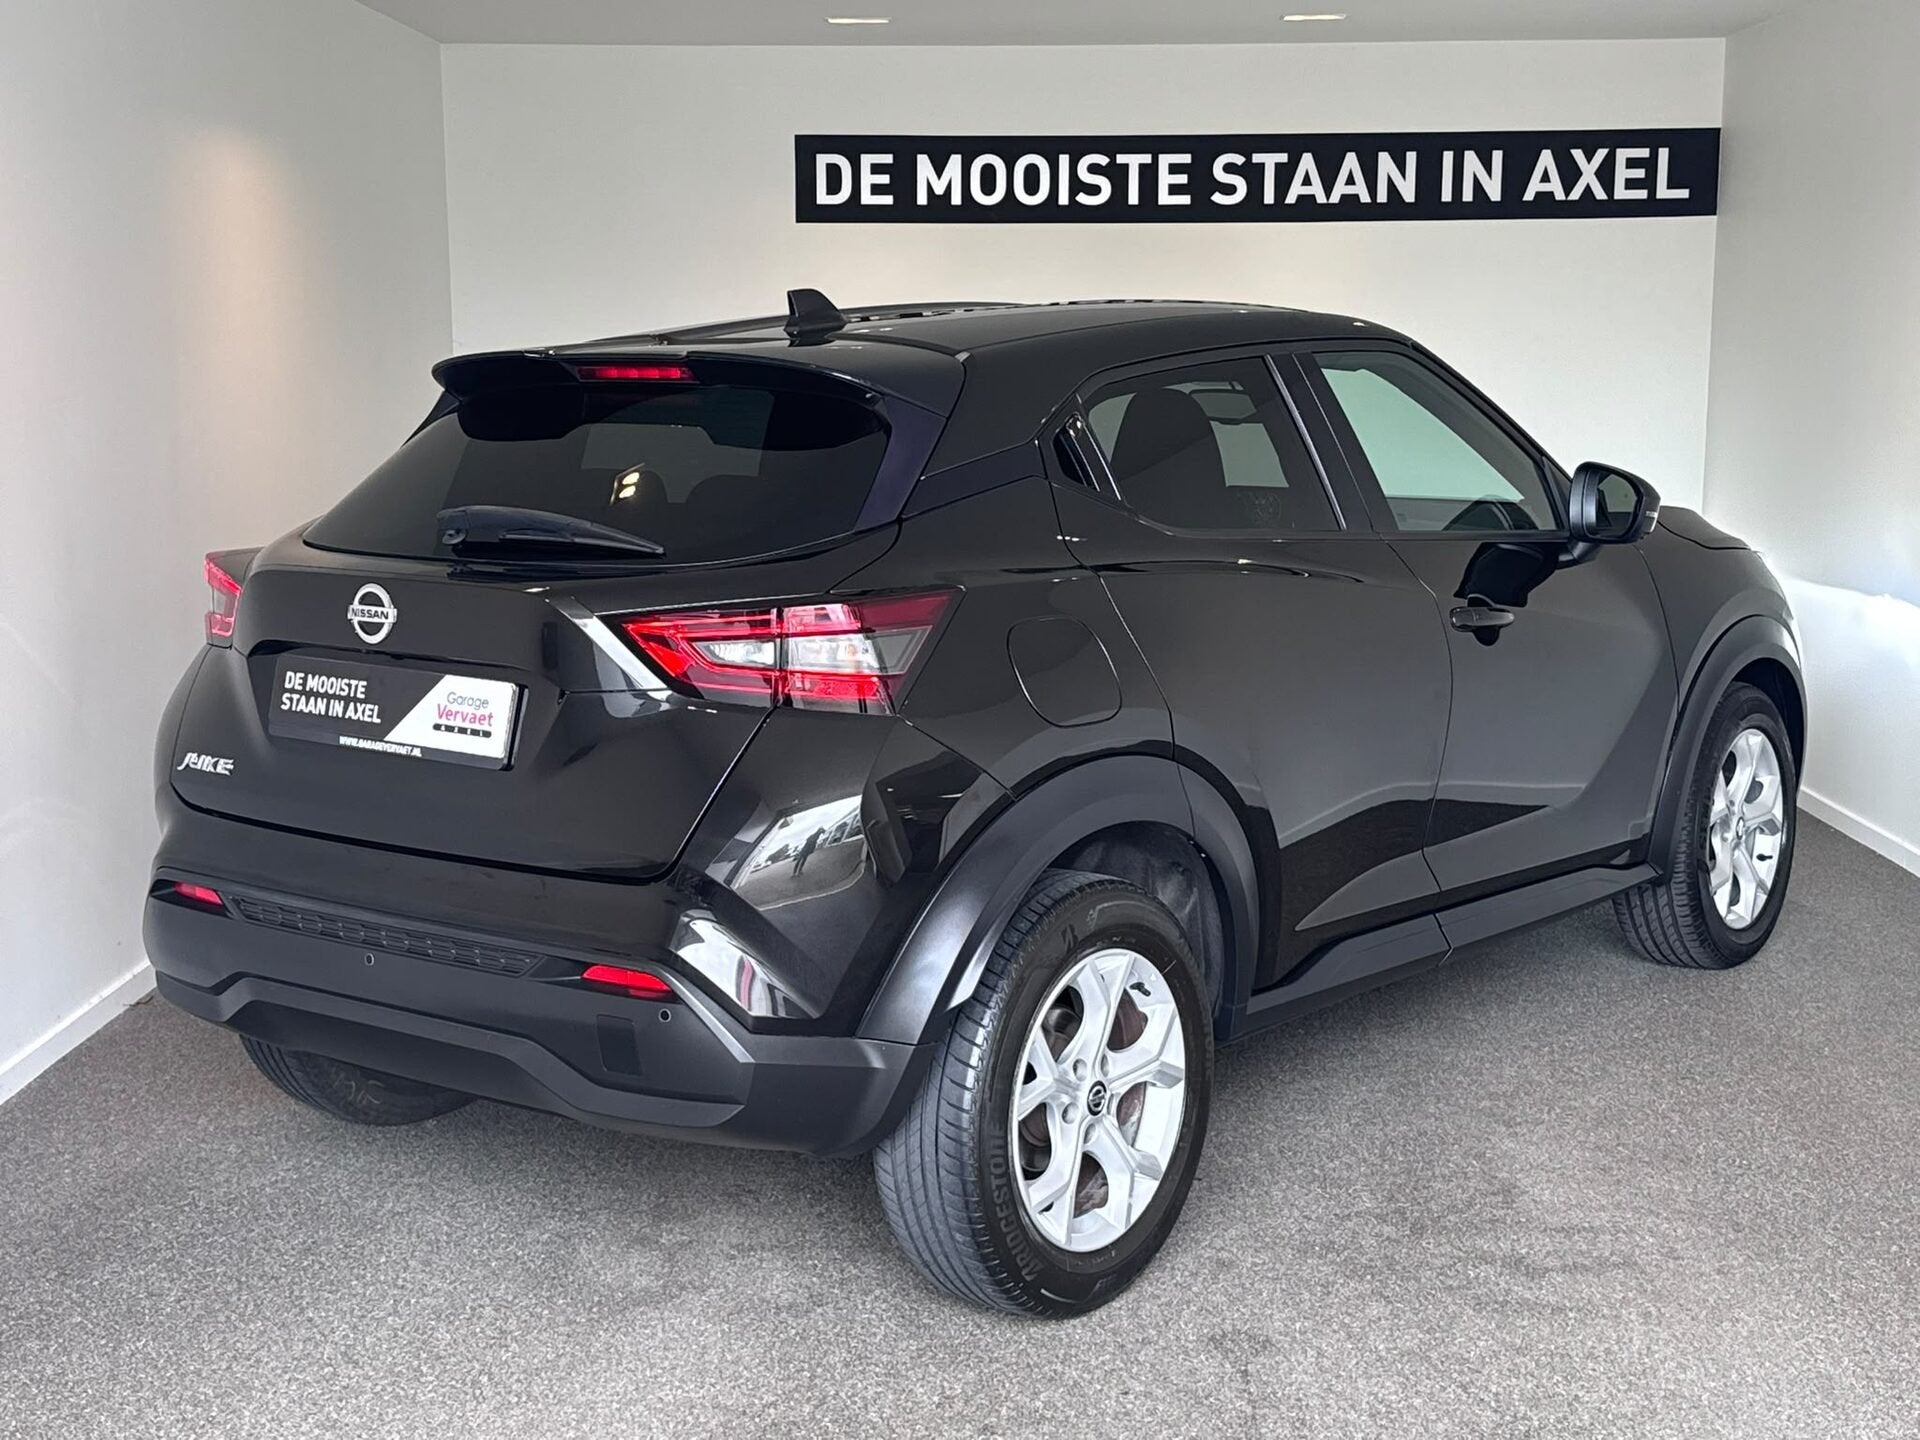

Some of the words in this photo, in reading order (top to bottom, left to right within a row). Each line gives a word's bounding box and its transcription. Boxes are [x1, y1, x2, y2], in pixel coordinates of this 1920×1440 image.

[815, 153, 894, 206] DE
[916, 153, 1192, 206] MOOISTE
[1210, 151, 1417, 205] STAAN
[1441, 150, 1503, 203] IN
[1522, 147, 1690, 202] AXEL
[351, 607, 389, 620] NISSAN
[284, 671, 305, 690] DE
[306, 674, 367, 699] MOOISTE
[281, 693, 327, 715] STAAN
[328, 699, 344, 718] IN
[345, 702, 381, 723] AXEL
[447, 691, 490, 710] Garage
[437, 703, 493, 727] Vervaet
[176, 752, 234, 776] JUKE
[990, 1122, 1046, 1282] BRIDGESTONE
